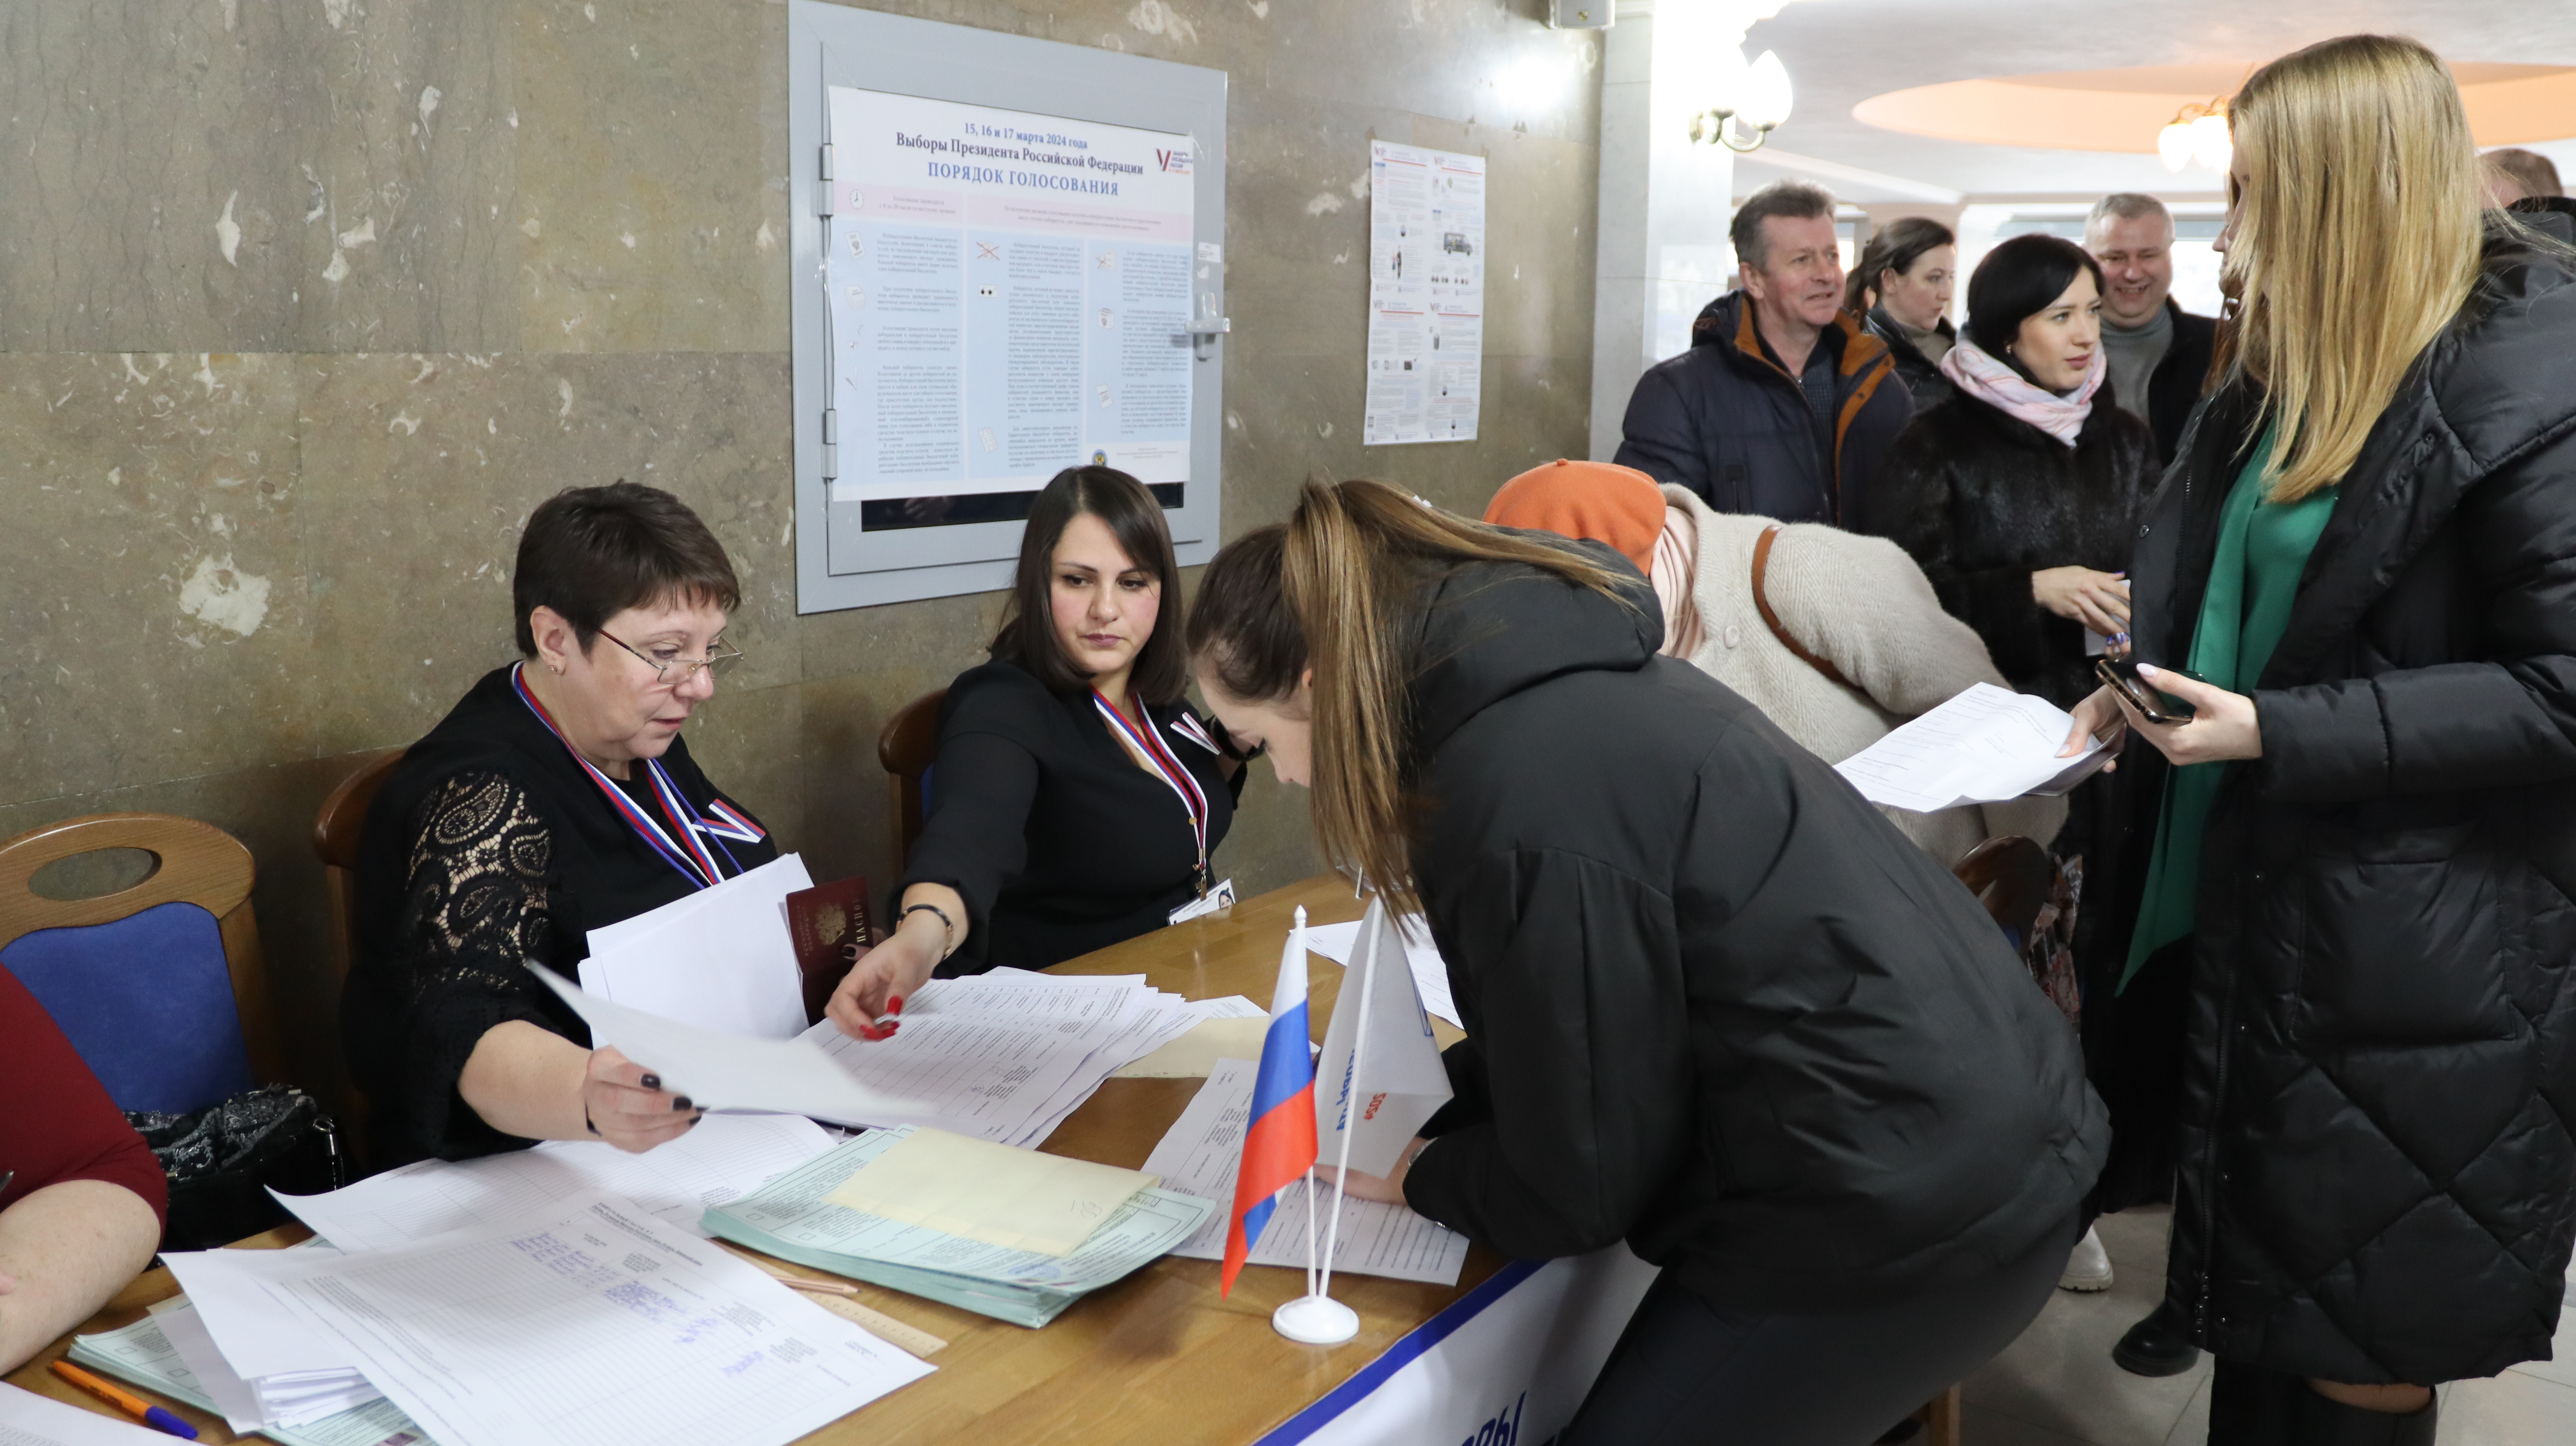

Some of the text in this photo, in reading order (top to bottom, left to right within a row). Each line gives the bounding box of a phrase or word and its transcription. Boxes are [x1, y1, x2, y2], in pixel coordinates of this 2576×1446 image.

[965, 123, 978, 136] 15,
[982, 125, 992, 136] 16
[1004, 128, 1014, 138] 17
[1016, 131, 1044, 144] марта
[1047, 133, 1066, 146] 2024
[1069, 139, 1088, 149] года
[896, 132, 1143, 175] Выборы Президента Российской Федерации
[928, 161, 1118, 195] ПОРЯДОК ГОЛОСОВАНИЯ
